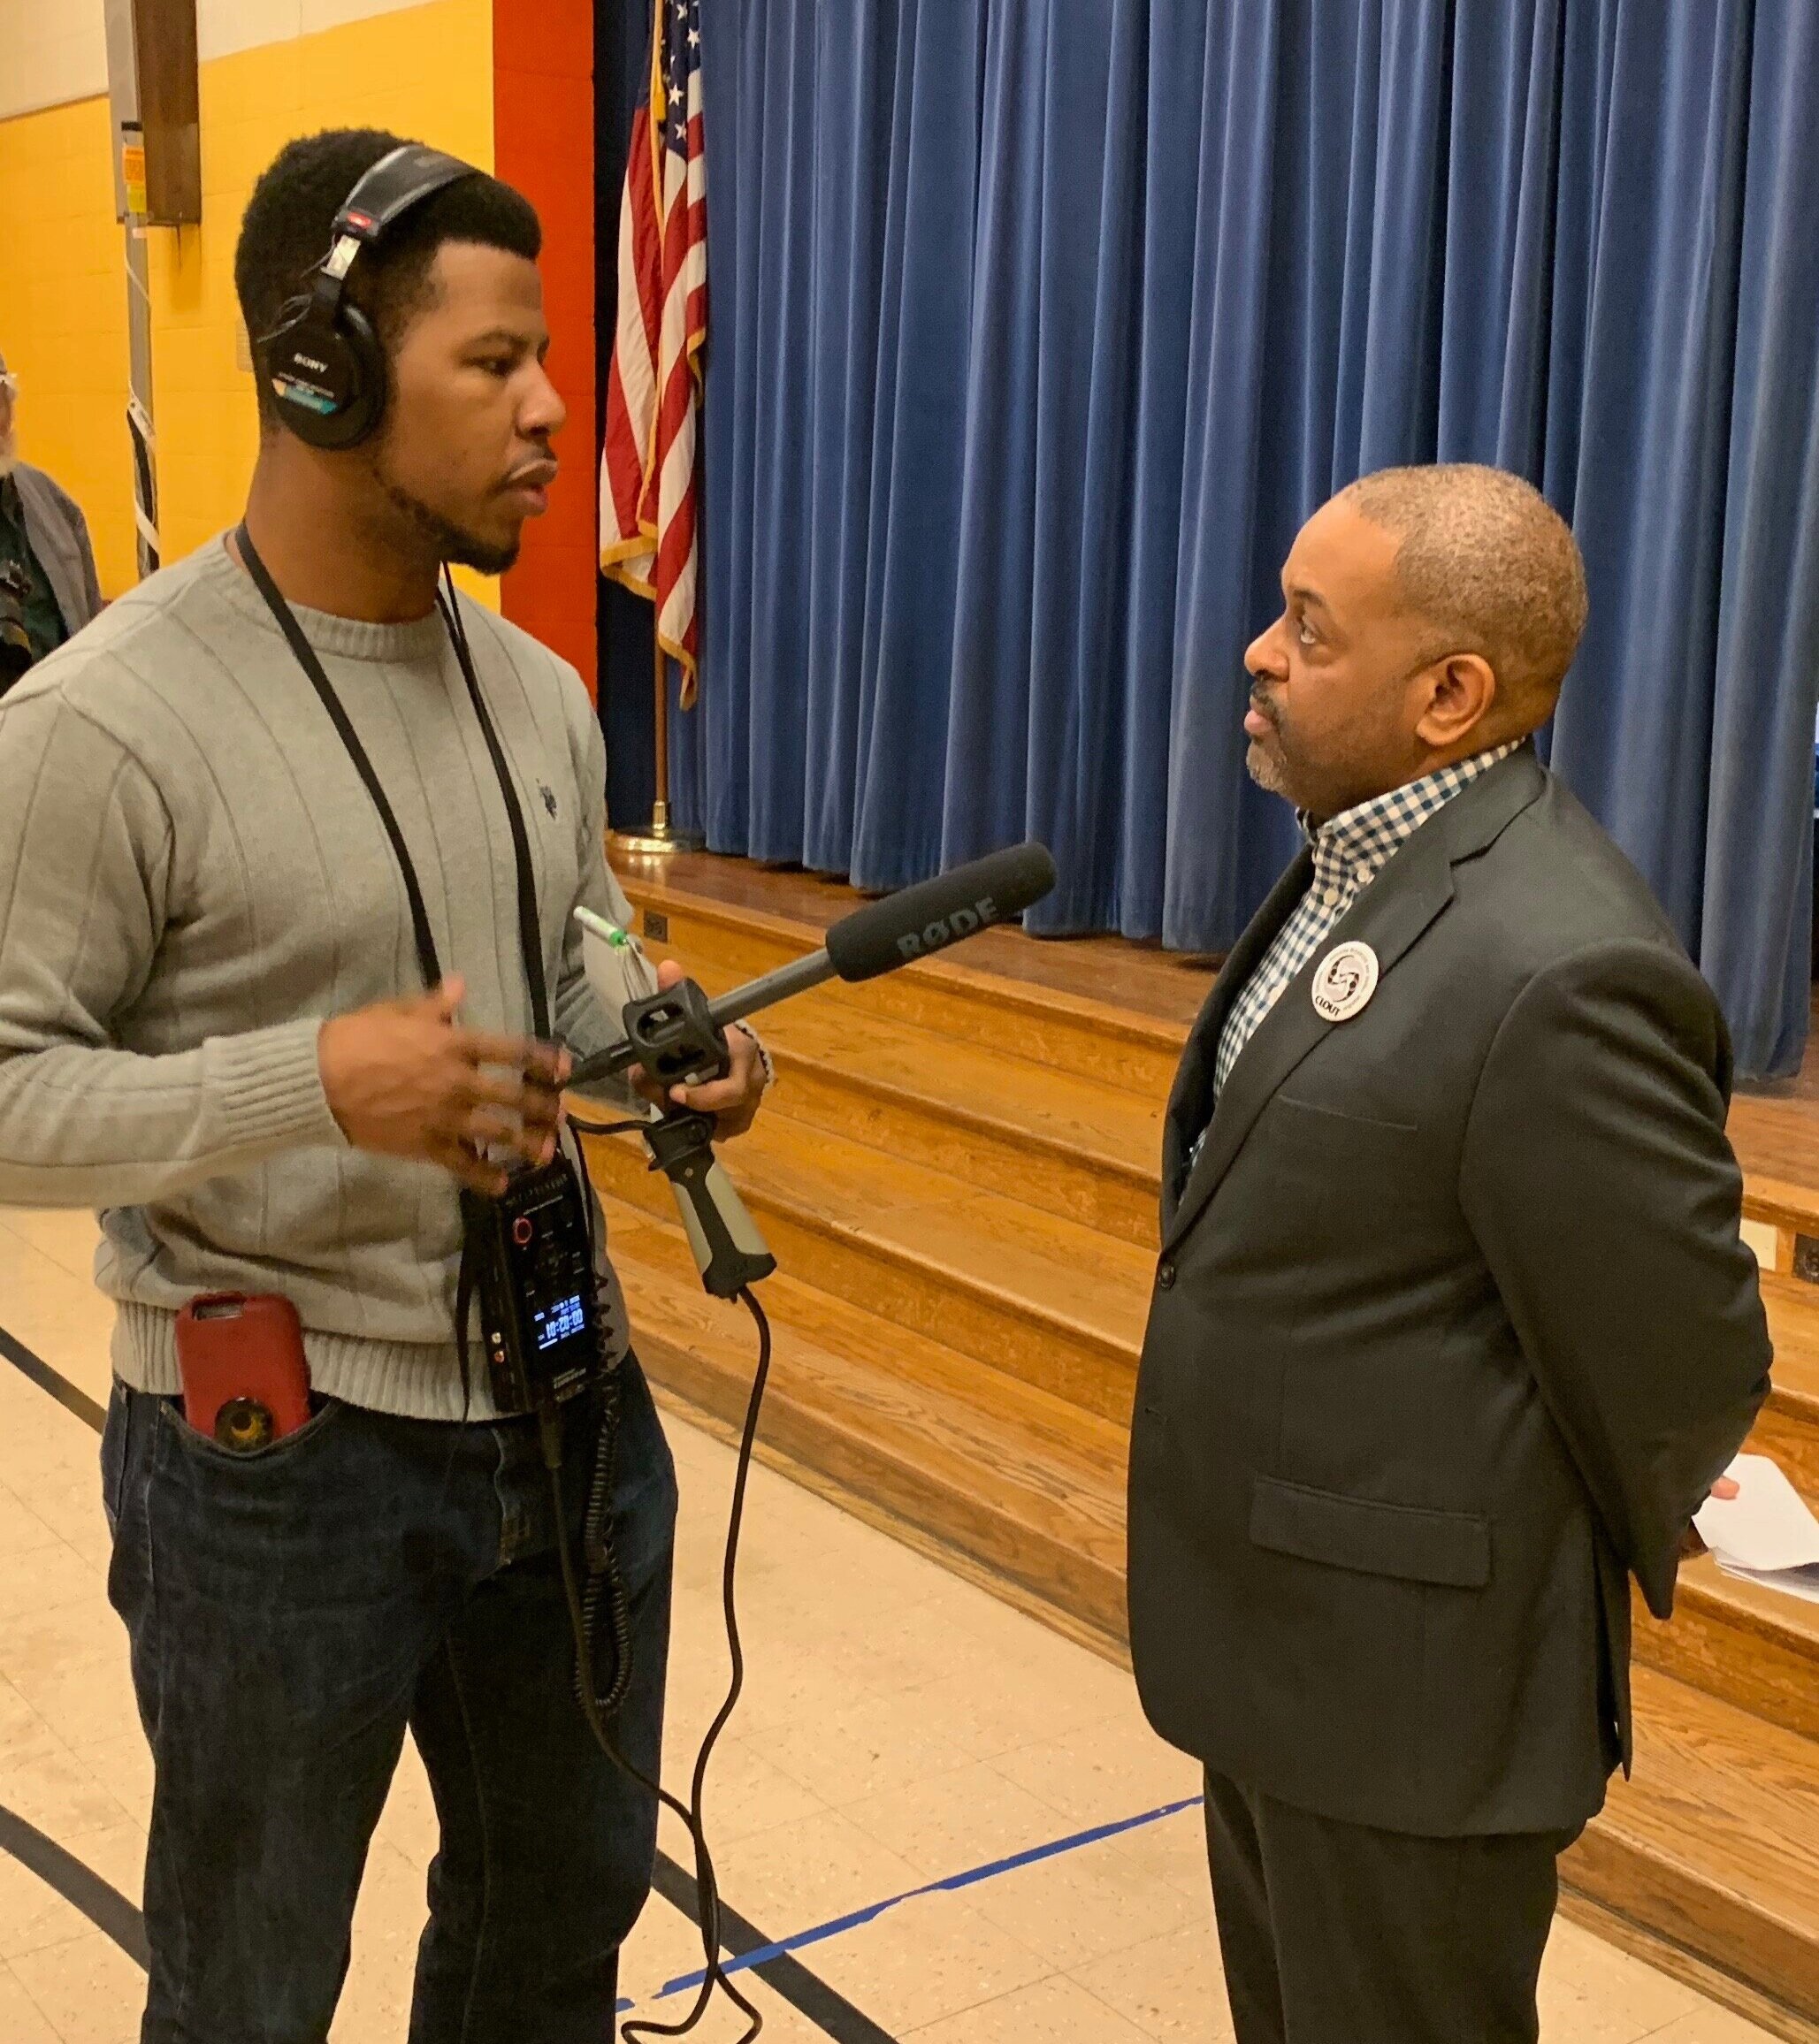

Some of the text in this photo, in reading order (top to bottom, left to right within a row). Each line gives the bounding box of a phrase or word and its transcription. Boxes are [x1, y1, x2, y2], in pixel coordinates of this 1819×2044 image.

[293, 352, 329, 373] SONY
[897, 896, 998, 957] RØDE
[1315, 995, 1341, 1017] CLOUT
